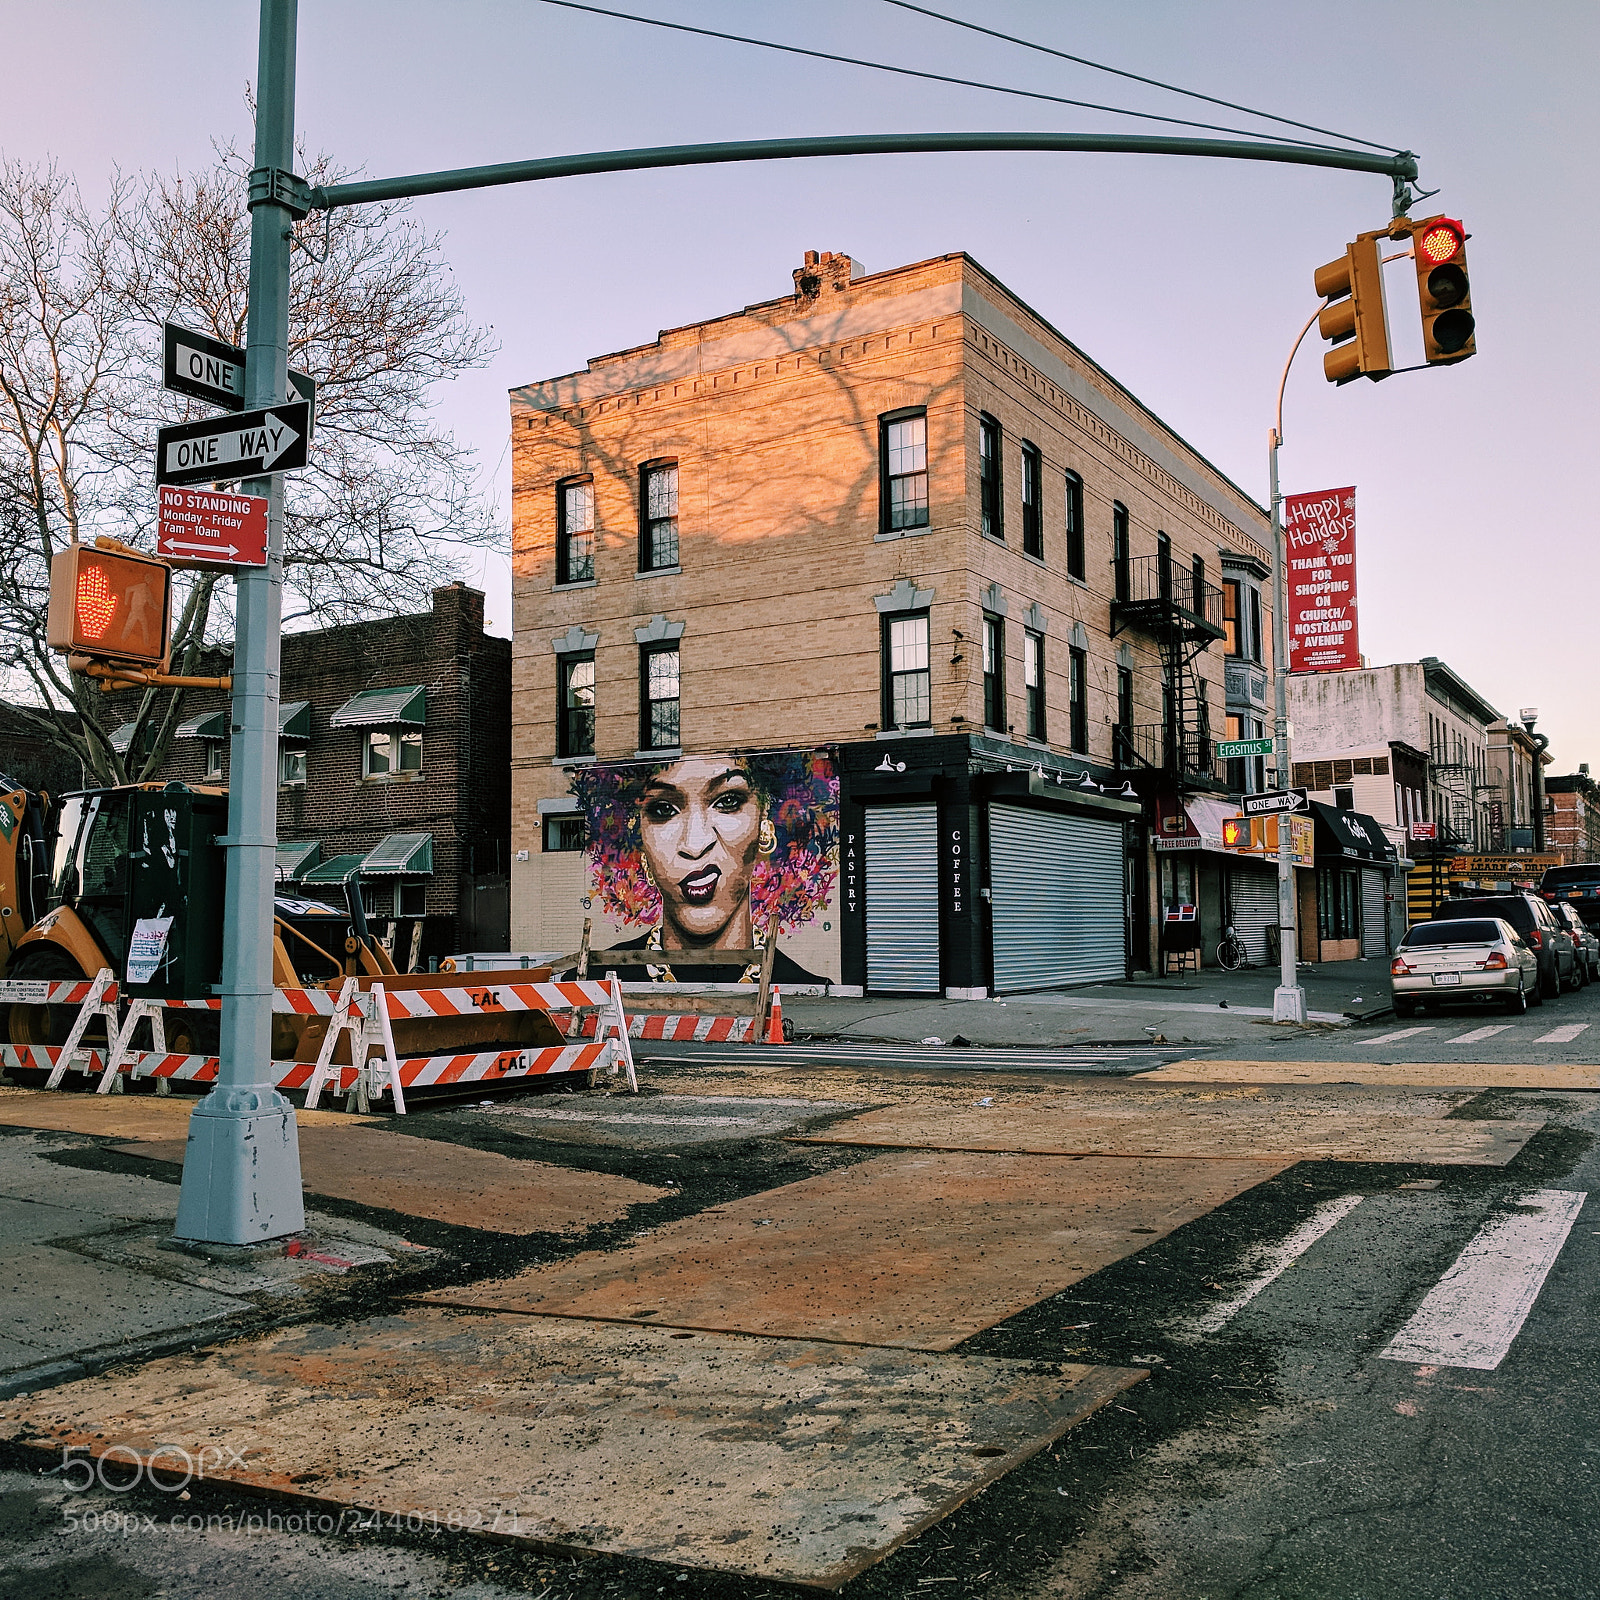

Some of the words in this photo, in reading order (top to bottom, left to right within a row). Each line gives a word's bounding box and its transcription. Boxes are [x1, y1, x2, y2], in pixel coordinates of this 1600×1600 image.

[190, 353, 234, 391] ONE
[177, 438, 219, 467] ONE
[239, 426, 285, 457] WAY
[164, 492, 183, 507] NO
[186, 495, 251, 514] STANDING
[1291, 495, 1341, 524] Happy
[163, 509, 202, 525] Monday
[212, 514, 242, 530] Friday
[163, 521, 185, 534] 7am
[194, 525, 220, 538] 10am
[1289, 514, 1355, 549] Holidays
[1291, 556, 1327, 570] THANK
[1330, 553, 1353, 566] YOU
[1311, 569, 1332, 581] FOR
[1295, 580, 1350, 596] SHOPPING
[1315, 595, 1331, 607] ON
[1299, 606, 1346, 621] CHURCH/
[1294, 620, 1353, 635] NOSTRAND
[1304, 634, 1344, 648] AVENUE
[1219, 743, 1262, 756] Erasmus
[1251, 799, 1270, 810] ONE
[1277, 795, 1297, 807] WAY
[1161, 840, 1175, 849] FREE
[1175, 838, 1201, 848] DELIVERY
[848, 834, 857, 913] PASTRY
[952, 830, 962, 912] COFFEE
[1470, 863, 1507, 871] LEARN
[472, 992, 500, 1007] CAC
[498, 1056, 526, 1072] CAC
